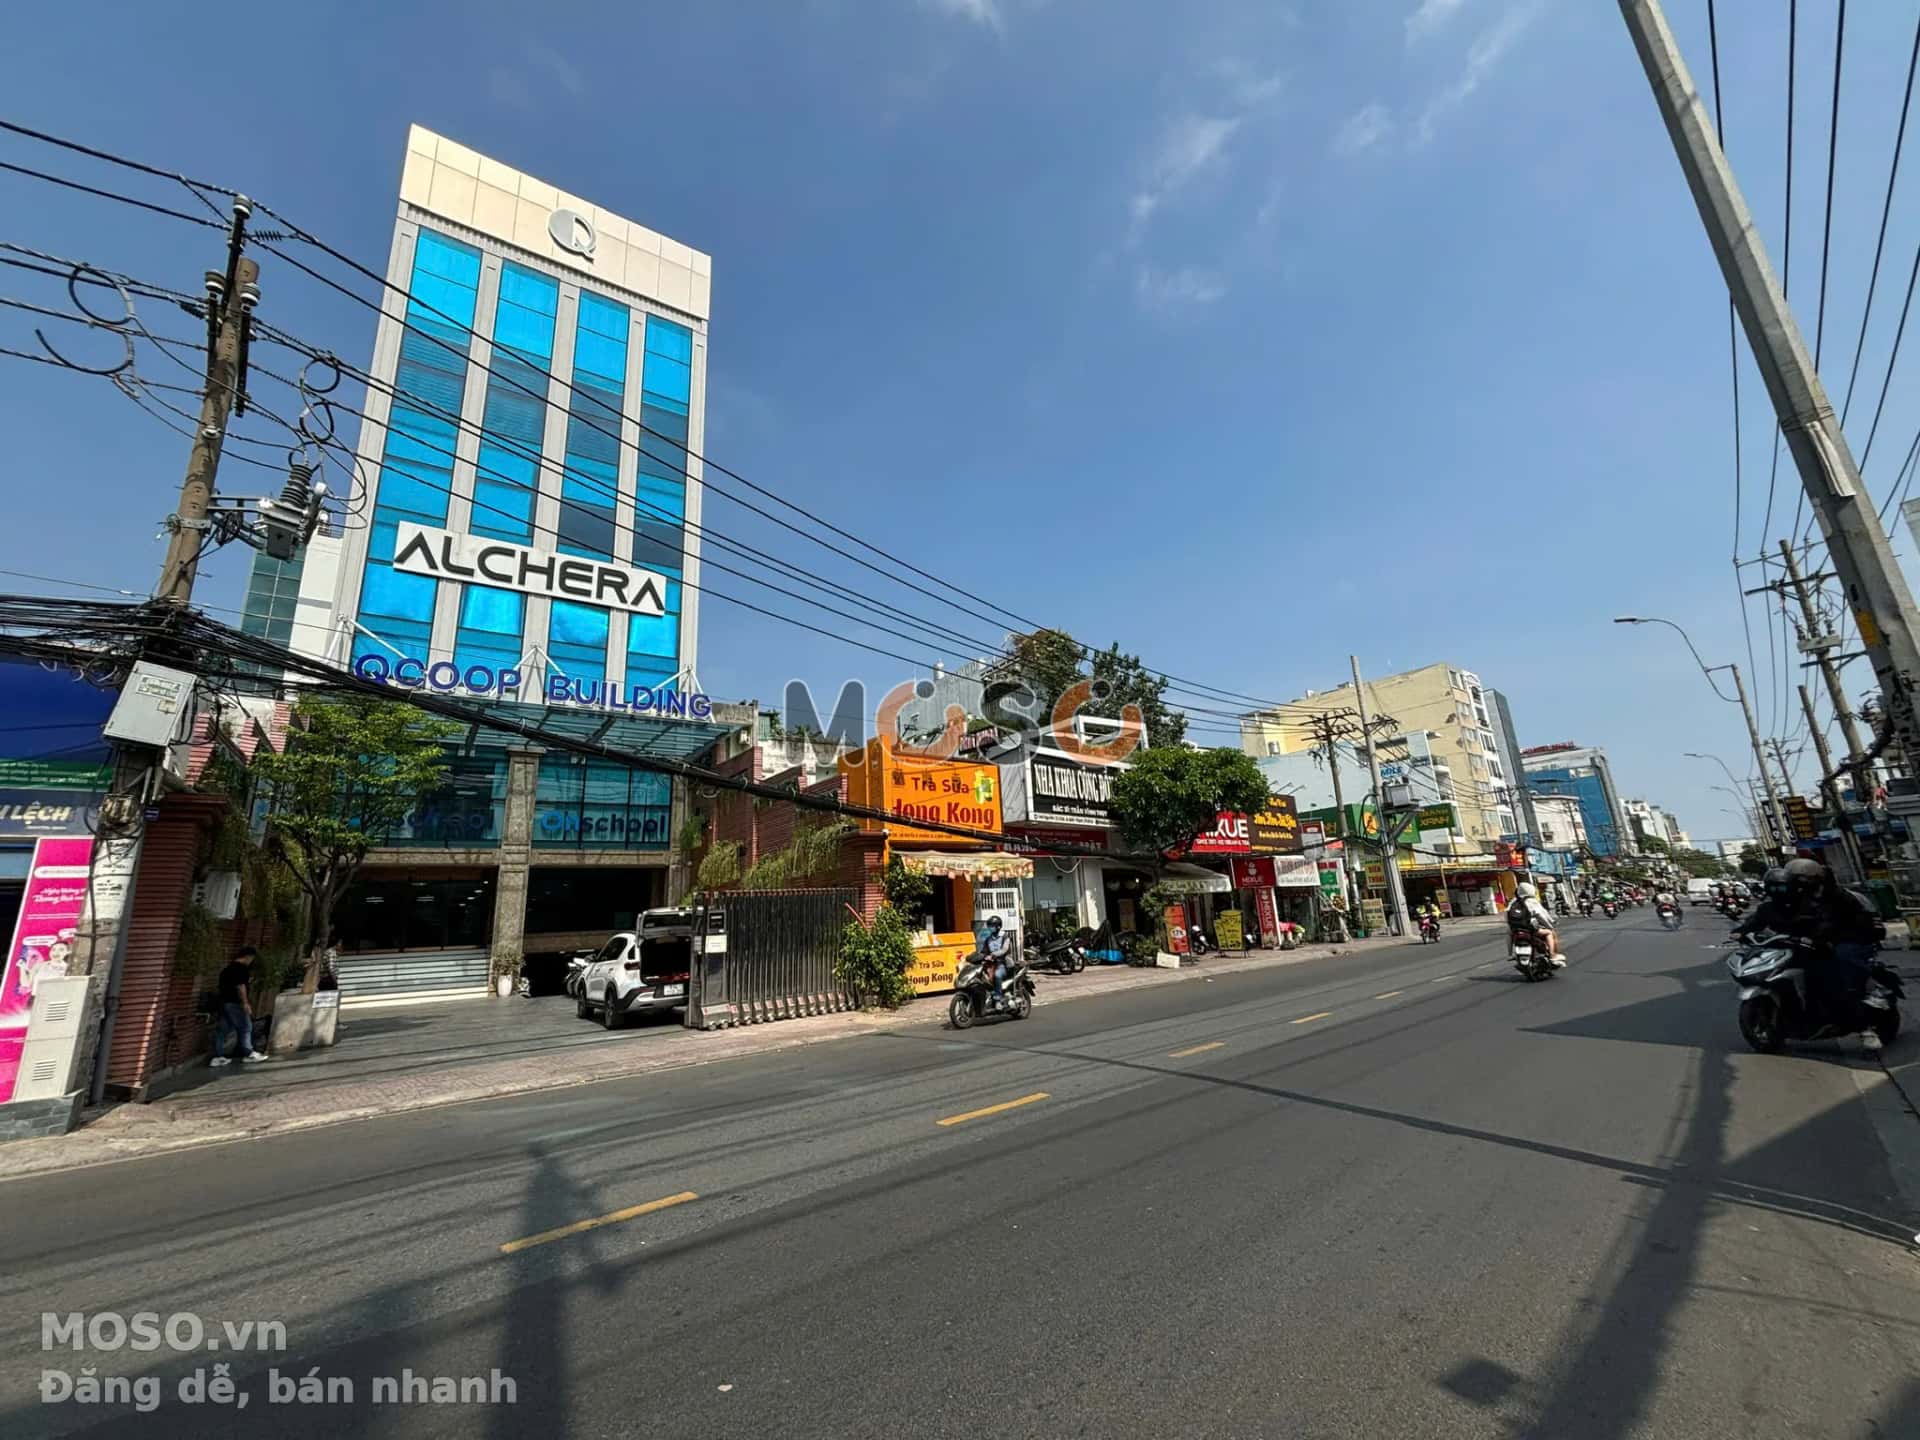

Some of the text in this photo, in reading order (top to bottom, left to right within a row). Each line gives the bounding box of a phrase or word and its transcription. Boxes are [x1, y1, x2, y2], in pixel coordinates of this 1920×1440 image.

[394, 531, 665, 611] ALCHERA
[355, 653, 712, 719] QCOOP BUILDING
[911, 774, 937, 792] Trà
[1034, 764, 1055, 796] NHA
[1054, 767, 1079, 800] KHOA
[10, 801, 72, 825] LỆCH
[541, 810, 666, 835] Onschool
[946, 802, 994, 830] Kong
[1206, 819, 1249, 838] XUE
[931, 973, 954, 983] Kong
